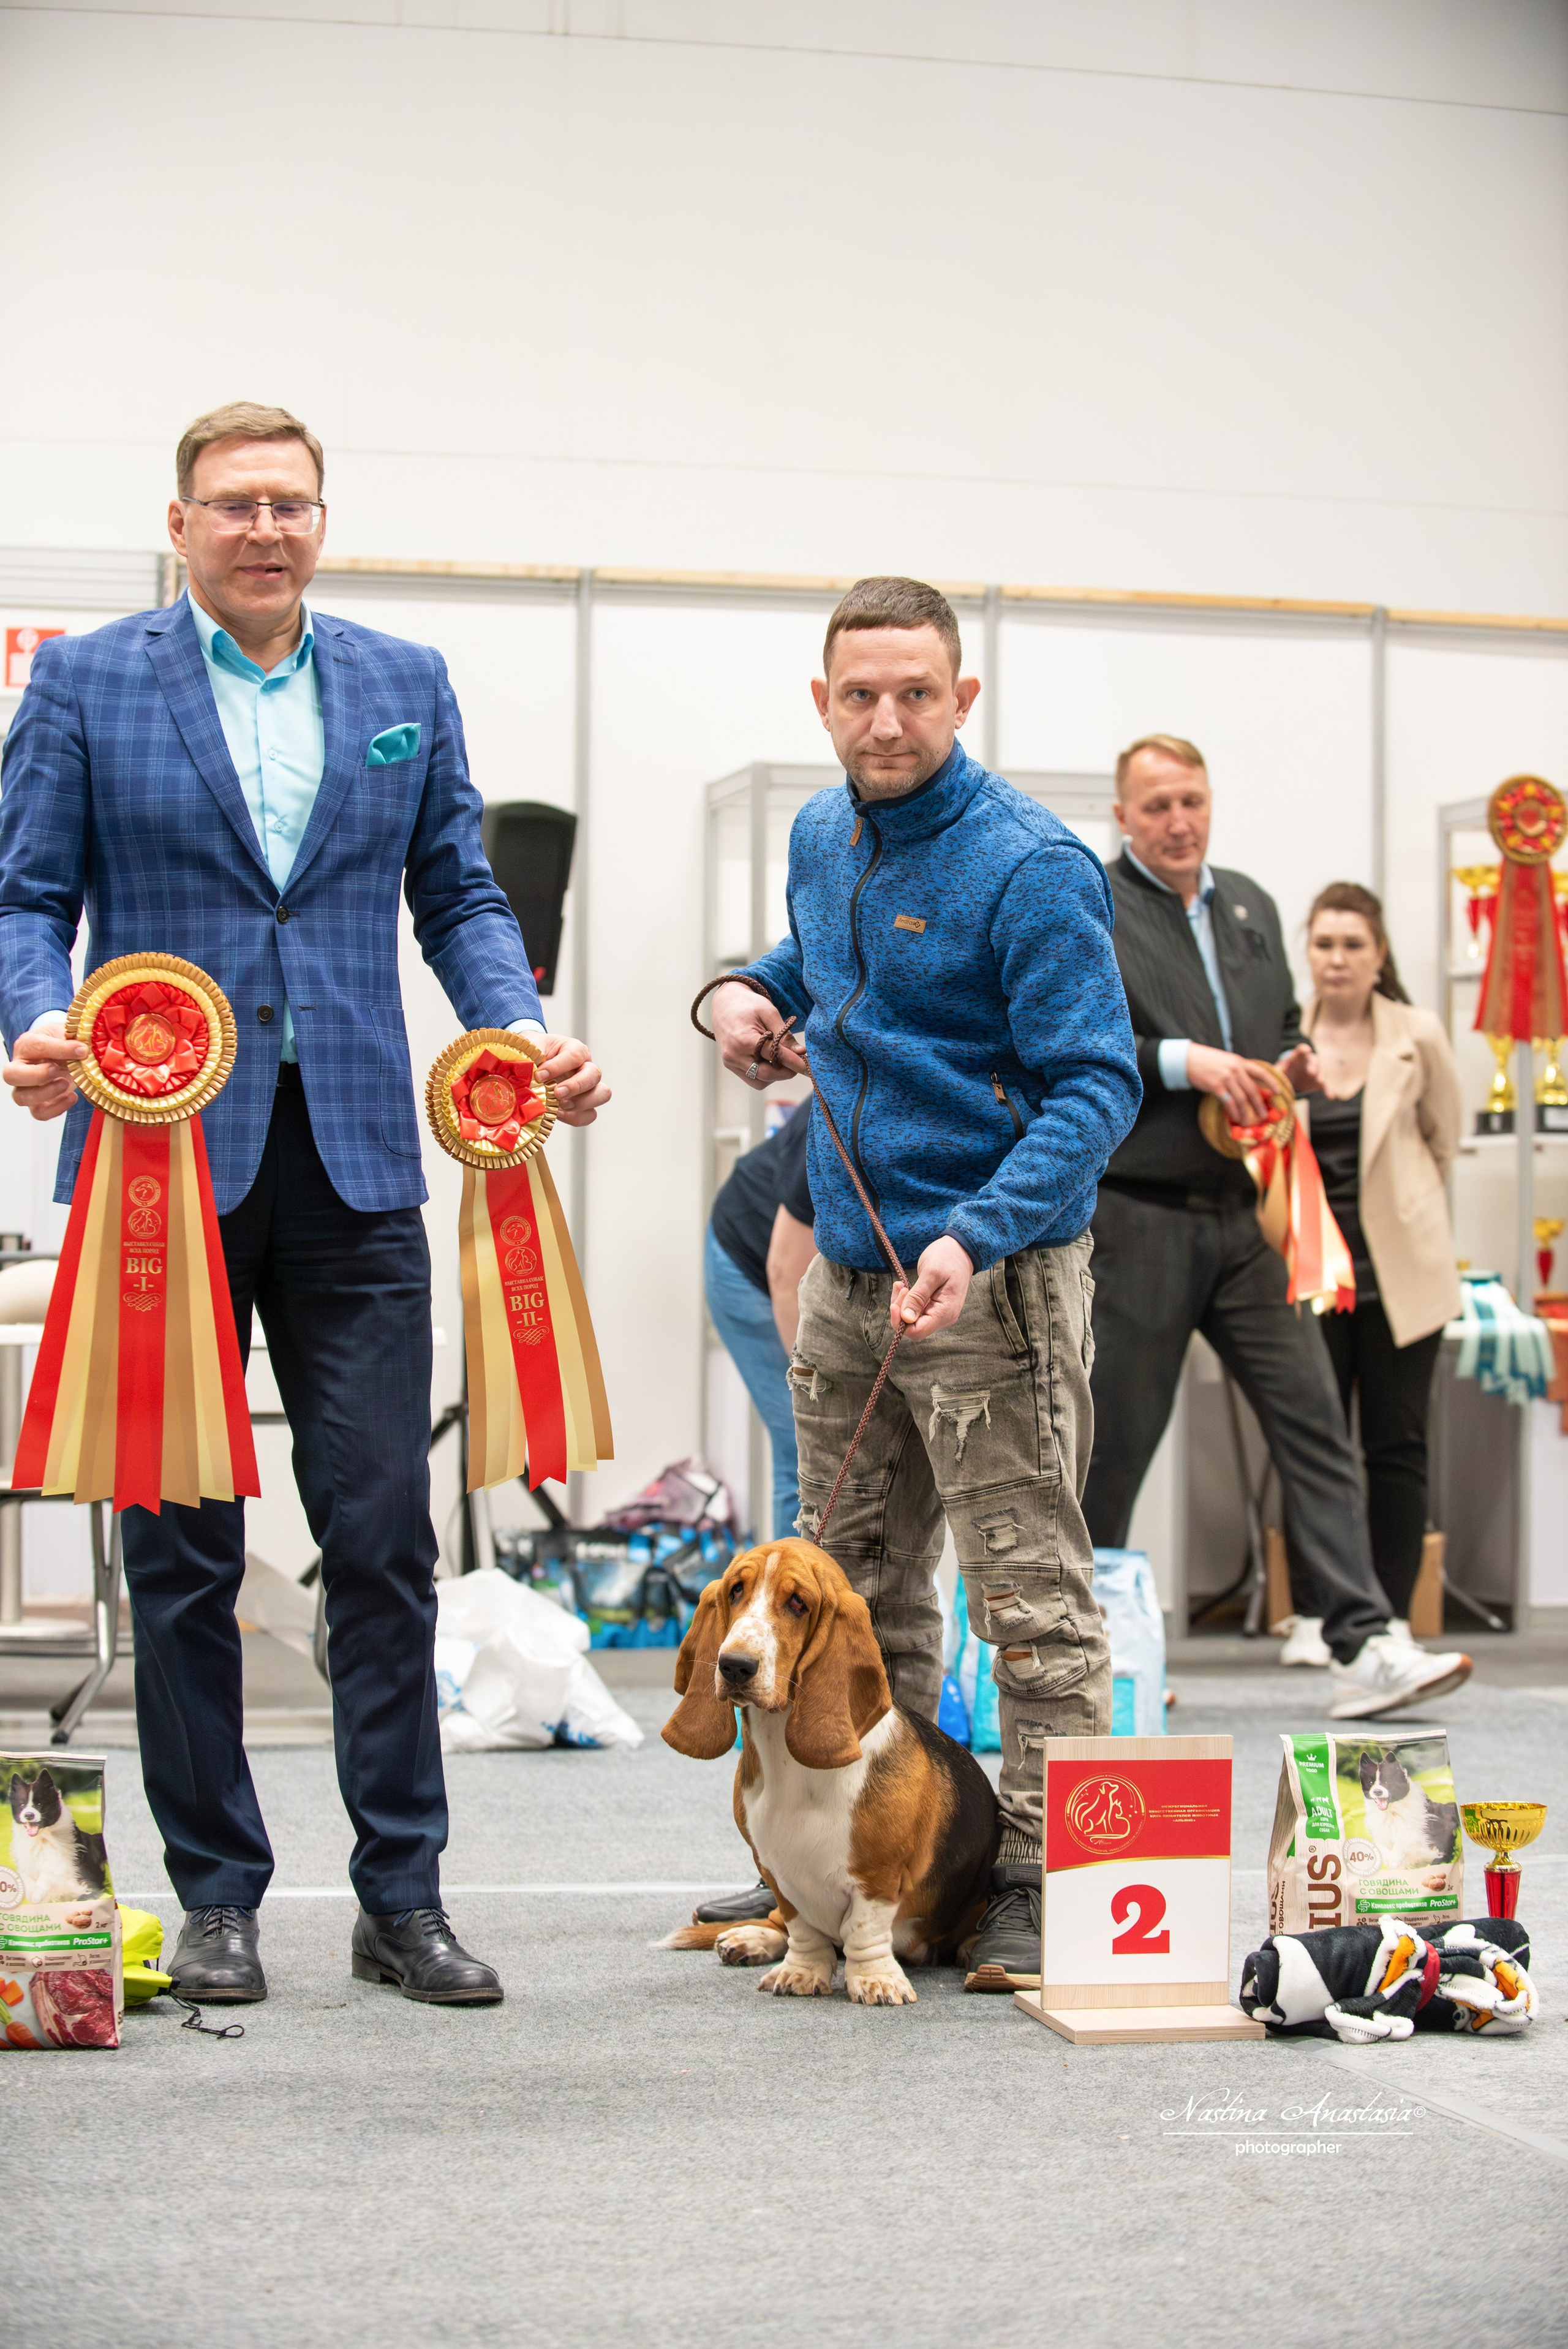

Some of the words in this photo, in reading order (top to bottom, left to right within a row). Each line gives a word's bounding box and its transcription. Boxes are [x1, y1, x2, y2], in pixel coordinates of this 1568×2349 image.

[125, 1257, 163, 1274] BIG
[505, 1278, 528, 1286] ВЫСТАВКА
[509, 1292, 545, 1311] BIG
[1311, 1807, 1333, 1819] ADULT
[1349, 1851, 1374, 1862] 40%
[1396, 1901, 1428, 1910] пробиотиков
[1430, 1899, 1457, 1907] ProStor+
[1110, 1883, 1170, 1955] 2
[7, 1923, 61, 1932] ОВОЩАМИ
[73, 1937, 108, 1945] ProStor+
